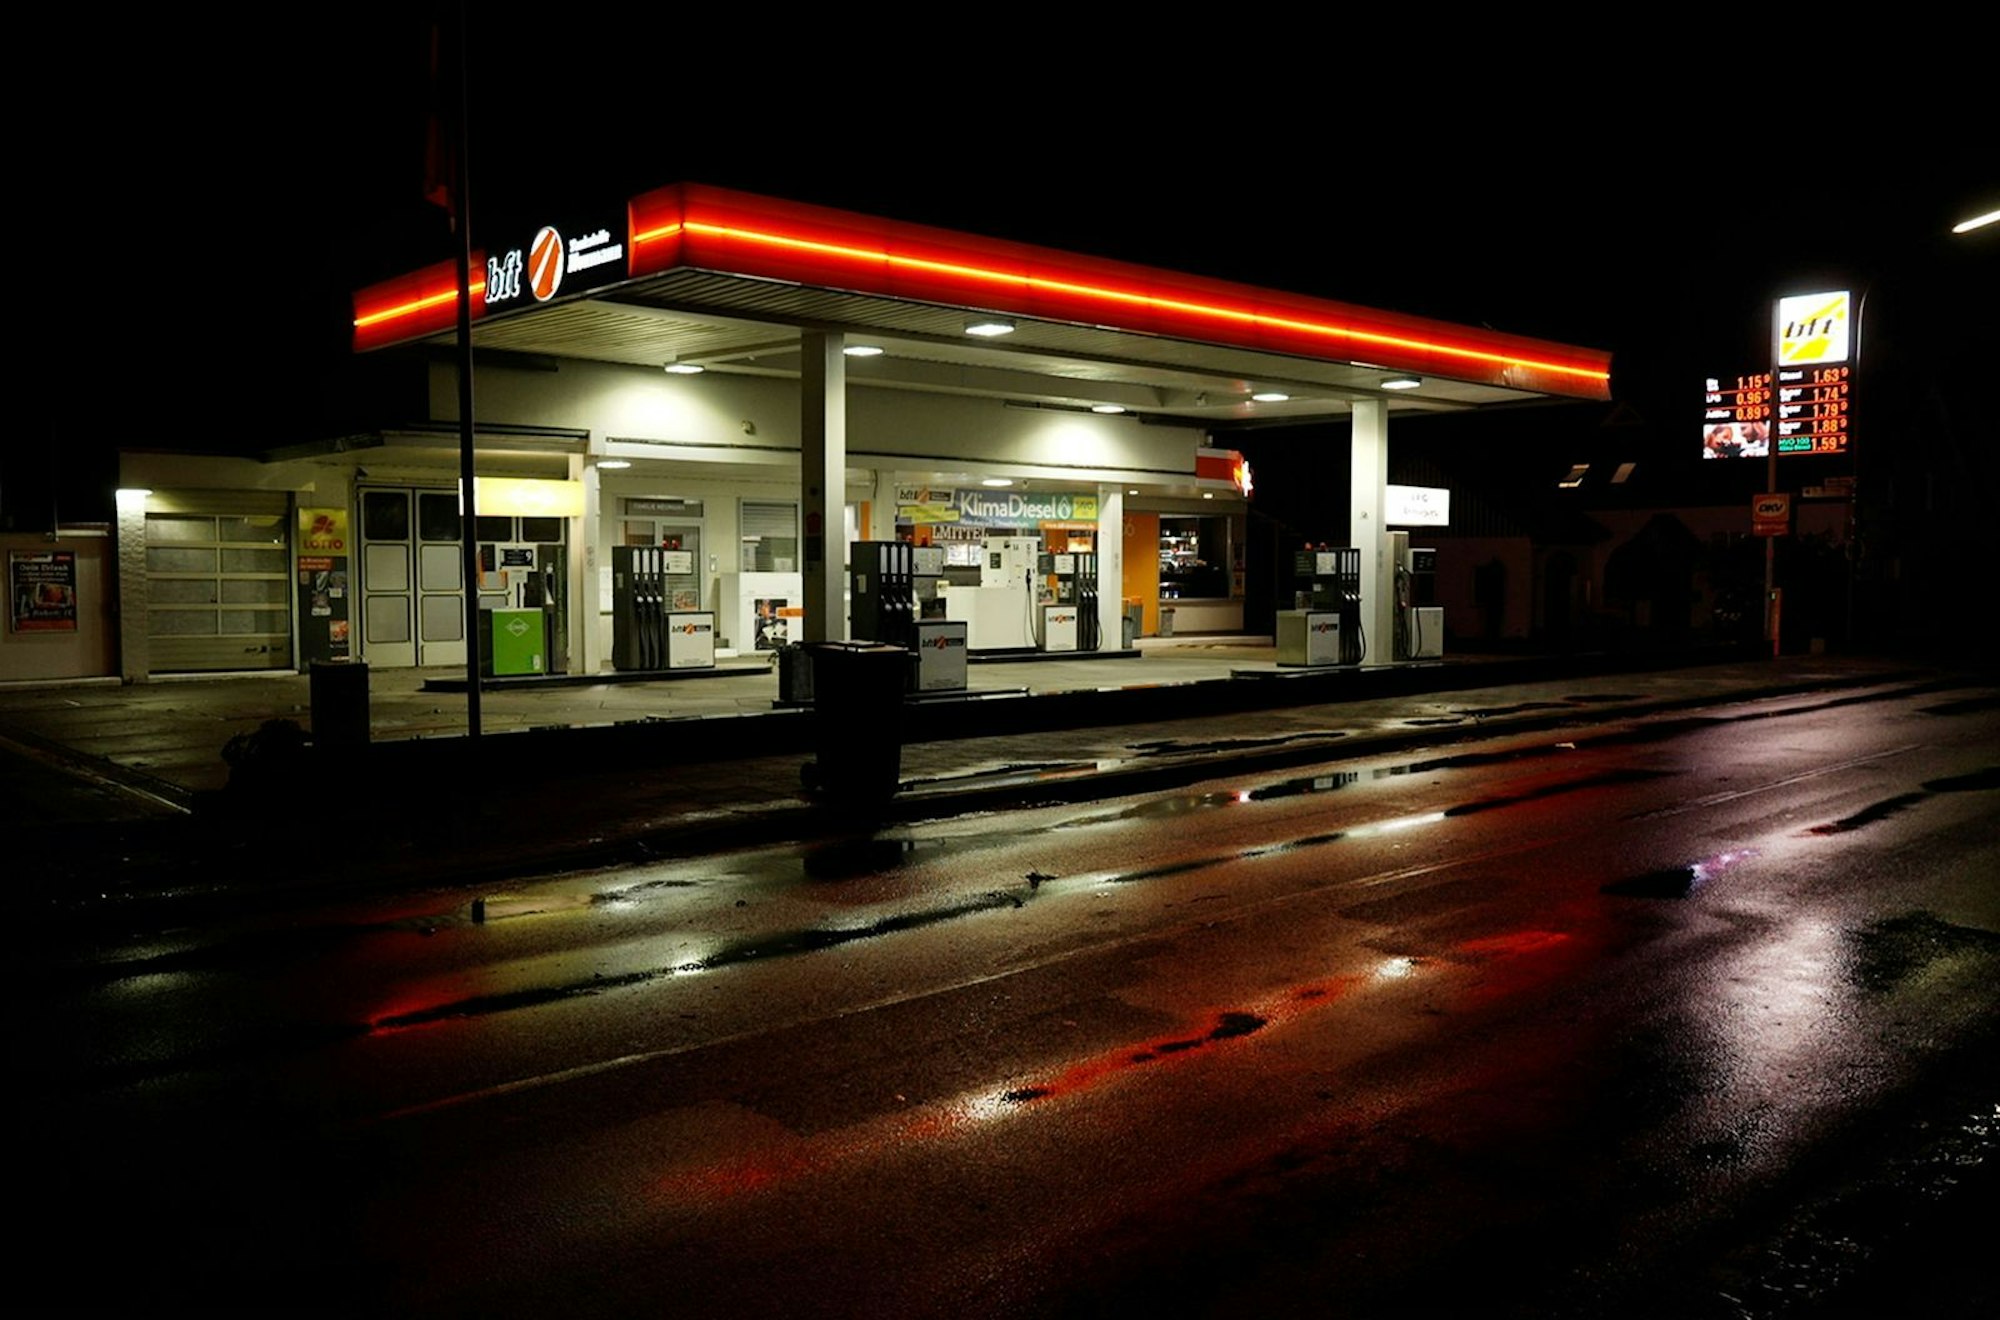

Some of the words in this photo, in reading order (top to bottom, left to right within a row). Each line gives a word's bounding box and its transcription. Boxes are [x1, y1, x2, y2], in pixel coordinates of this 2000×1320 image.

[485, 249, 522, 303] bft
[959, 491, 1056, 520] KlimaDiesel
[1759, 504, 1783, 512] DKV
[303, 539, 344, 551] LOTTO
